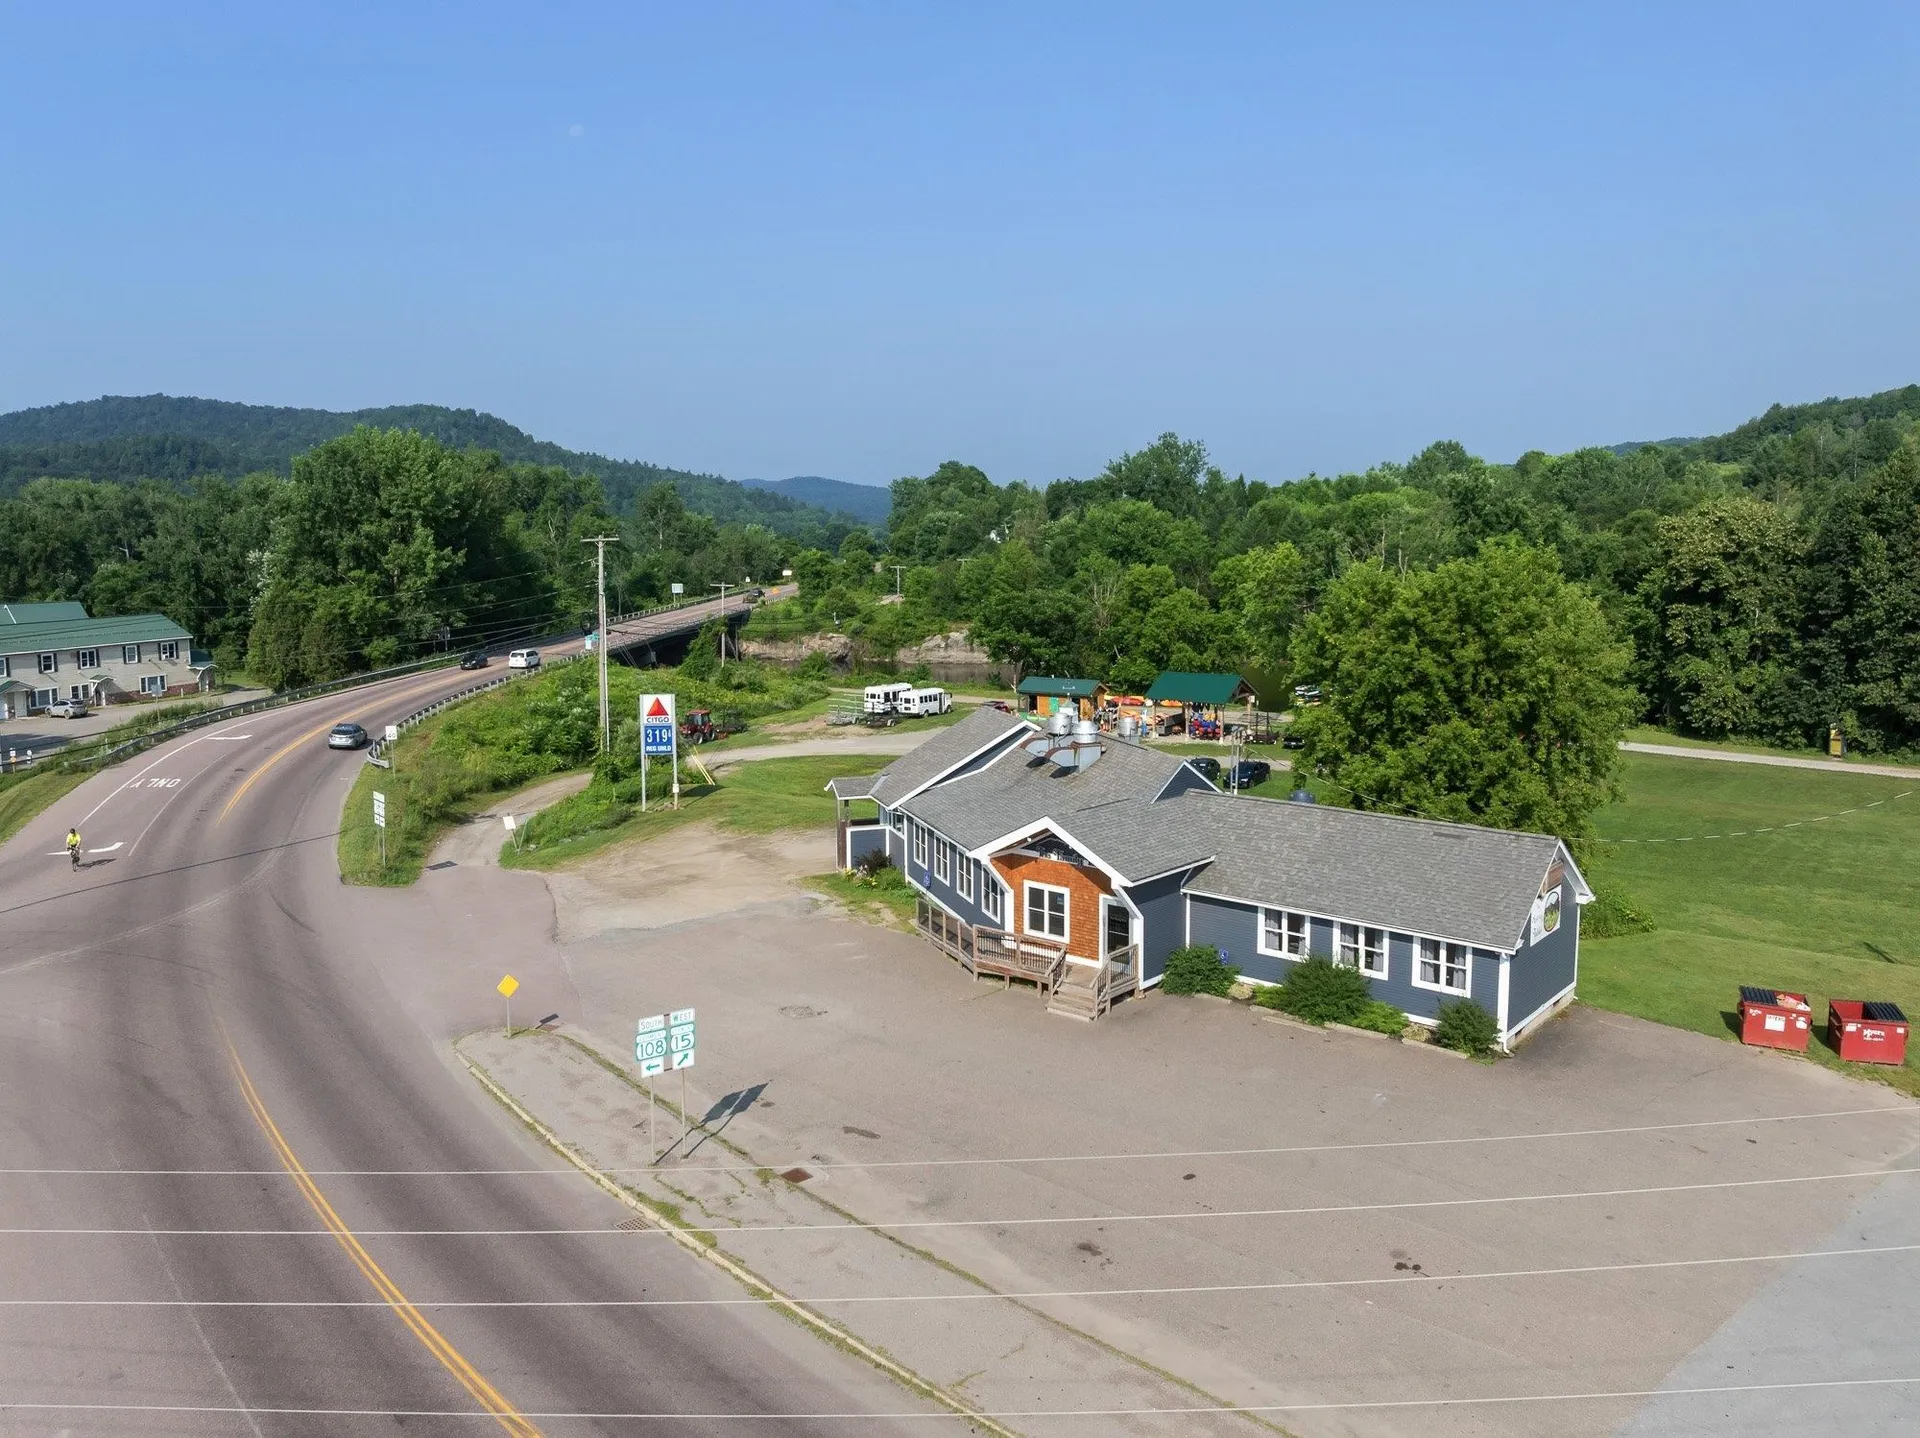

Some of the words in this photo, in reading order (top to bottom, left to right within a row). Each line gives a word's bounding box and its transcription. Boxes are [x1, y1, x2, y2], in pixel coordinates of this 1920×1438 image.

[647, 729, 668, 743] 319
[129, 778, 181, 788] ONLY
[673, 1012, 691, 1022] WEST
[675, 1033, 691, 1050] 15
[640, 1040, 664, 1058] 108
